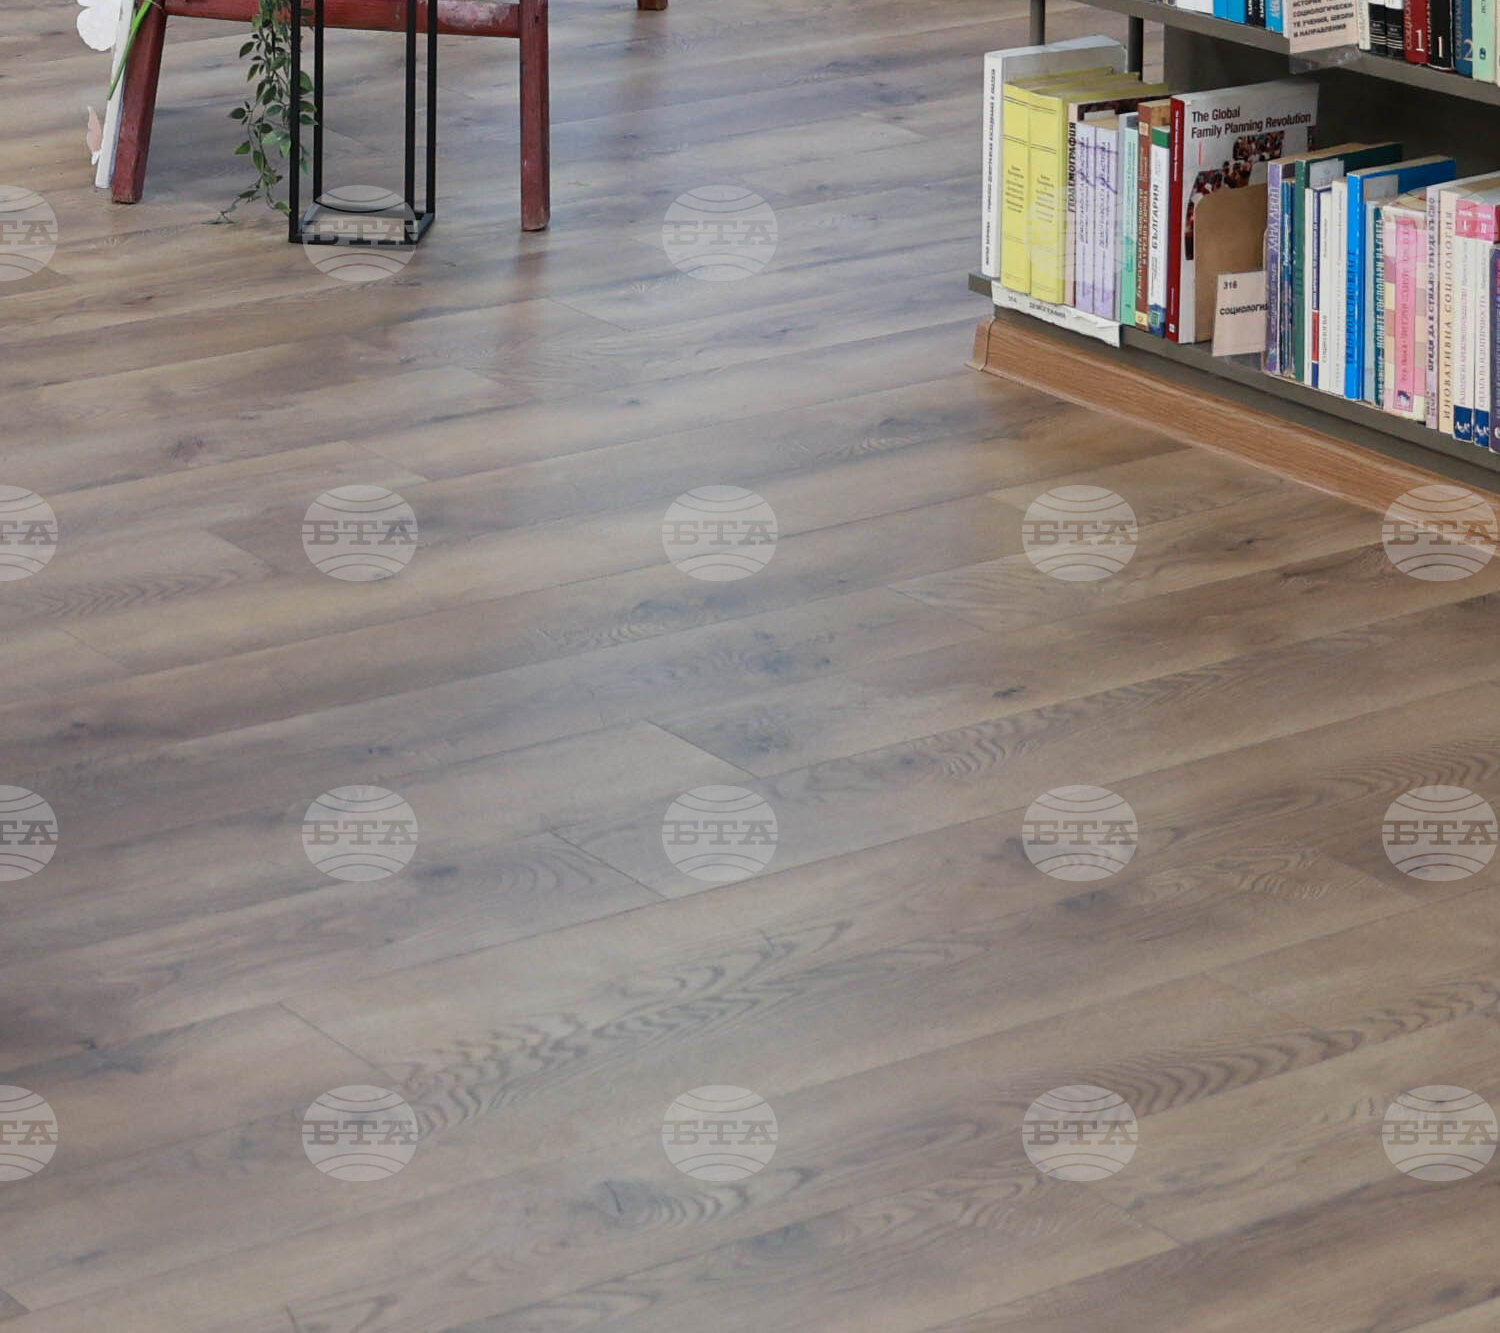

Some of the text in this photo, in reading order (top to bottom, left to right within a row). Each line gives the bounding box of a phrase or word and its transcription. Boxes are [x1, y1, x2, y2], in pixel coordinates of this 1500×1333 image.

[1191, 111, 1312, 140] Family Planning Revolution
[1192, 105, 1241, 123] The Global
